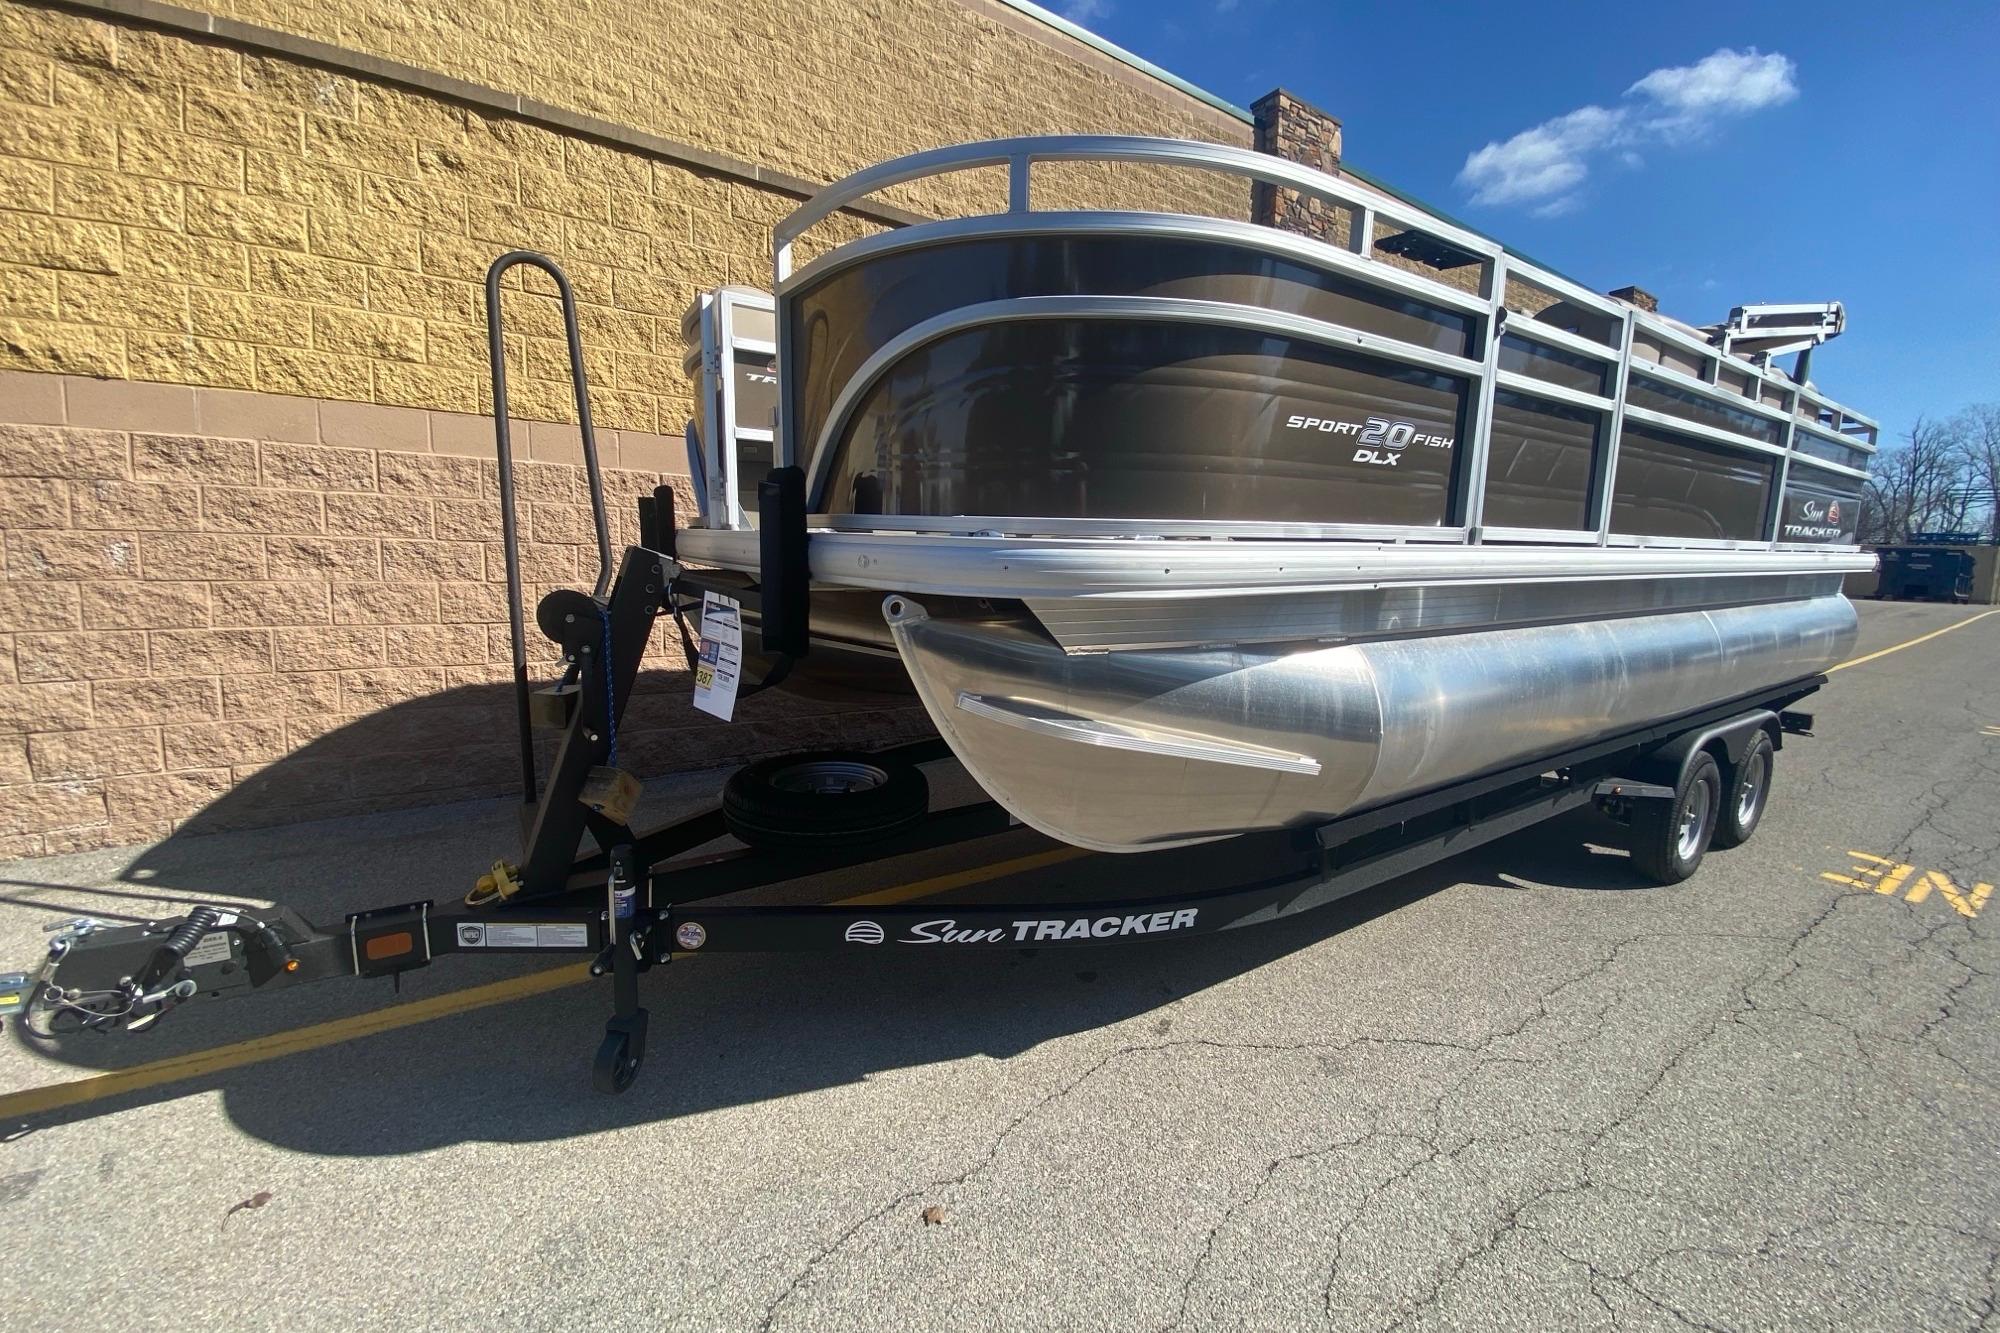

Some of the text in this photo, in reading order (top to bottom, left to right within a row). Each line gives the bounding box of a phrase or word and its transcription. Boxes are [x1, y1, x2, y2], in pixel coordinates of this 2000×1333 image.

[1286, 415, 1454, 451] SPORT 20 FISH
[1353, 449, 1401, 466] DLX
[1801, 500, 1824, 522] Sun
[1784, 525, 1841, 538] TRACKER
[897, 907, 1199, 944] Sun TRACKER
